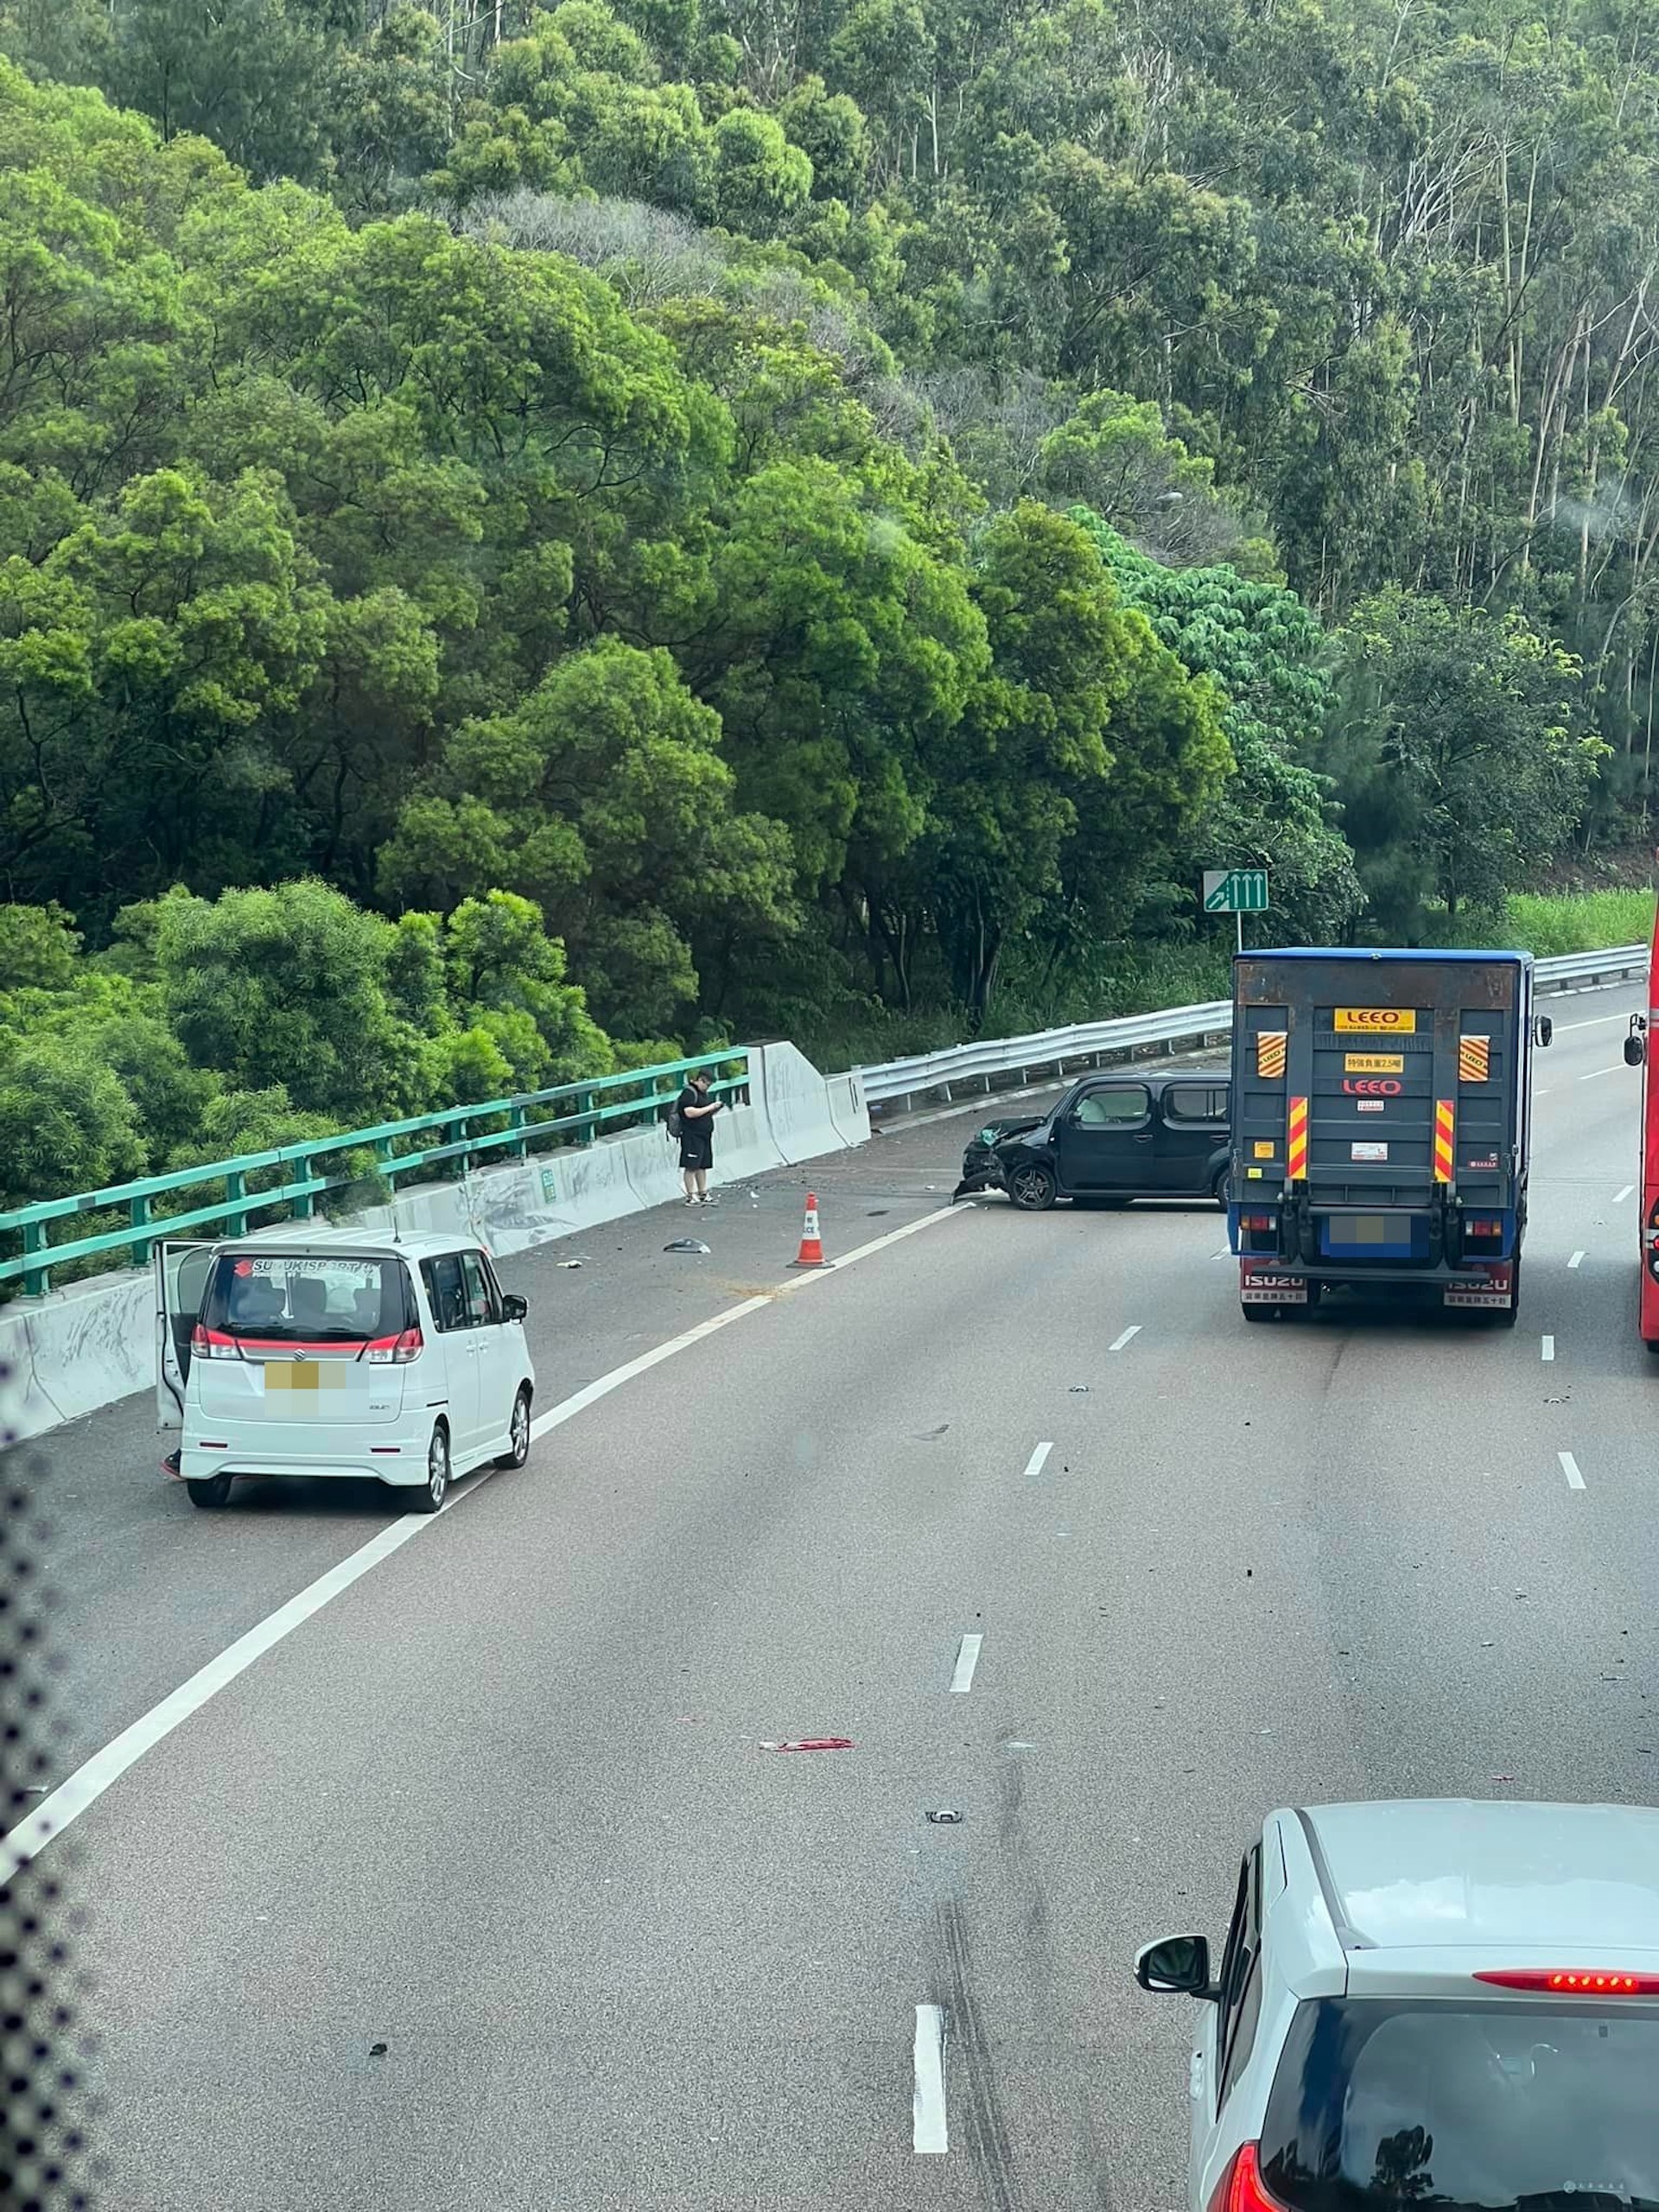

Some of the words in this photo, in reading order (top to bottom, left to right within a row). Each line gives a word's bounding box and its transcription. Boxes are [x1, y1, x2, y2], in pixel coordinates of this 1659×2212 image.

[1347, 1012, 1399, 1024] LEEO
[1342, 1079, 1402, 1095] LEEO
[1244, 1274, 1304, 1287] ISUZU
